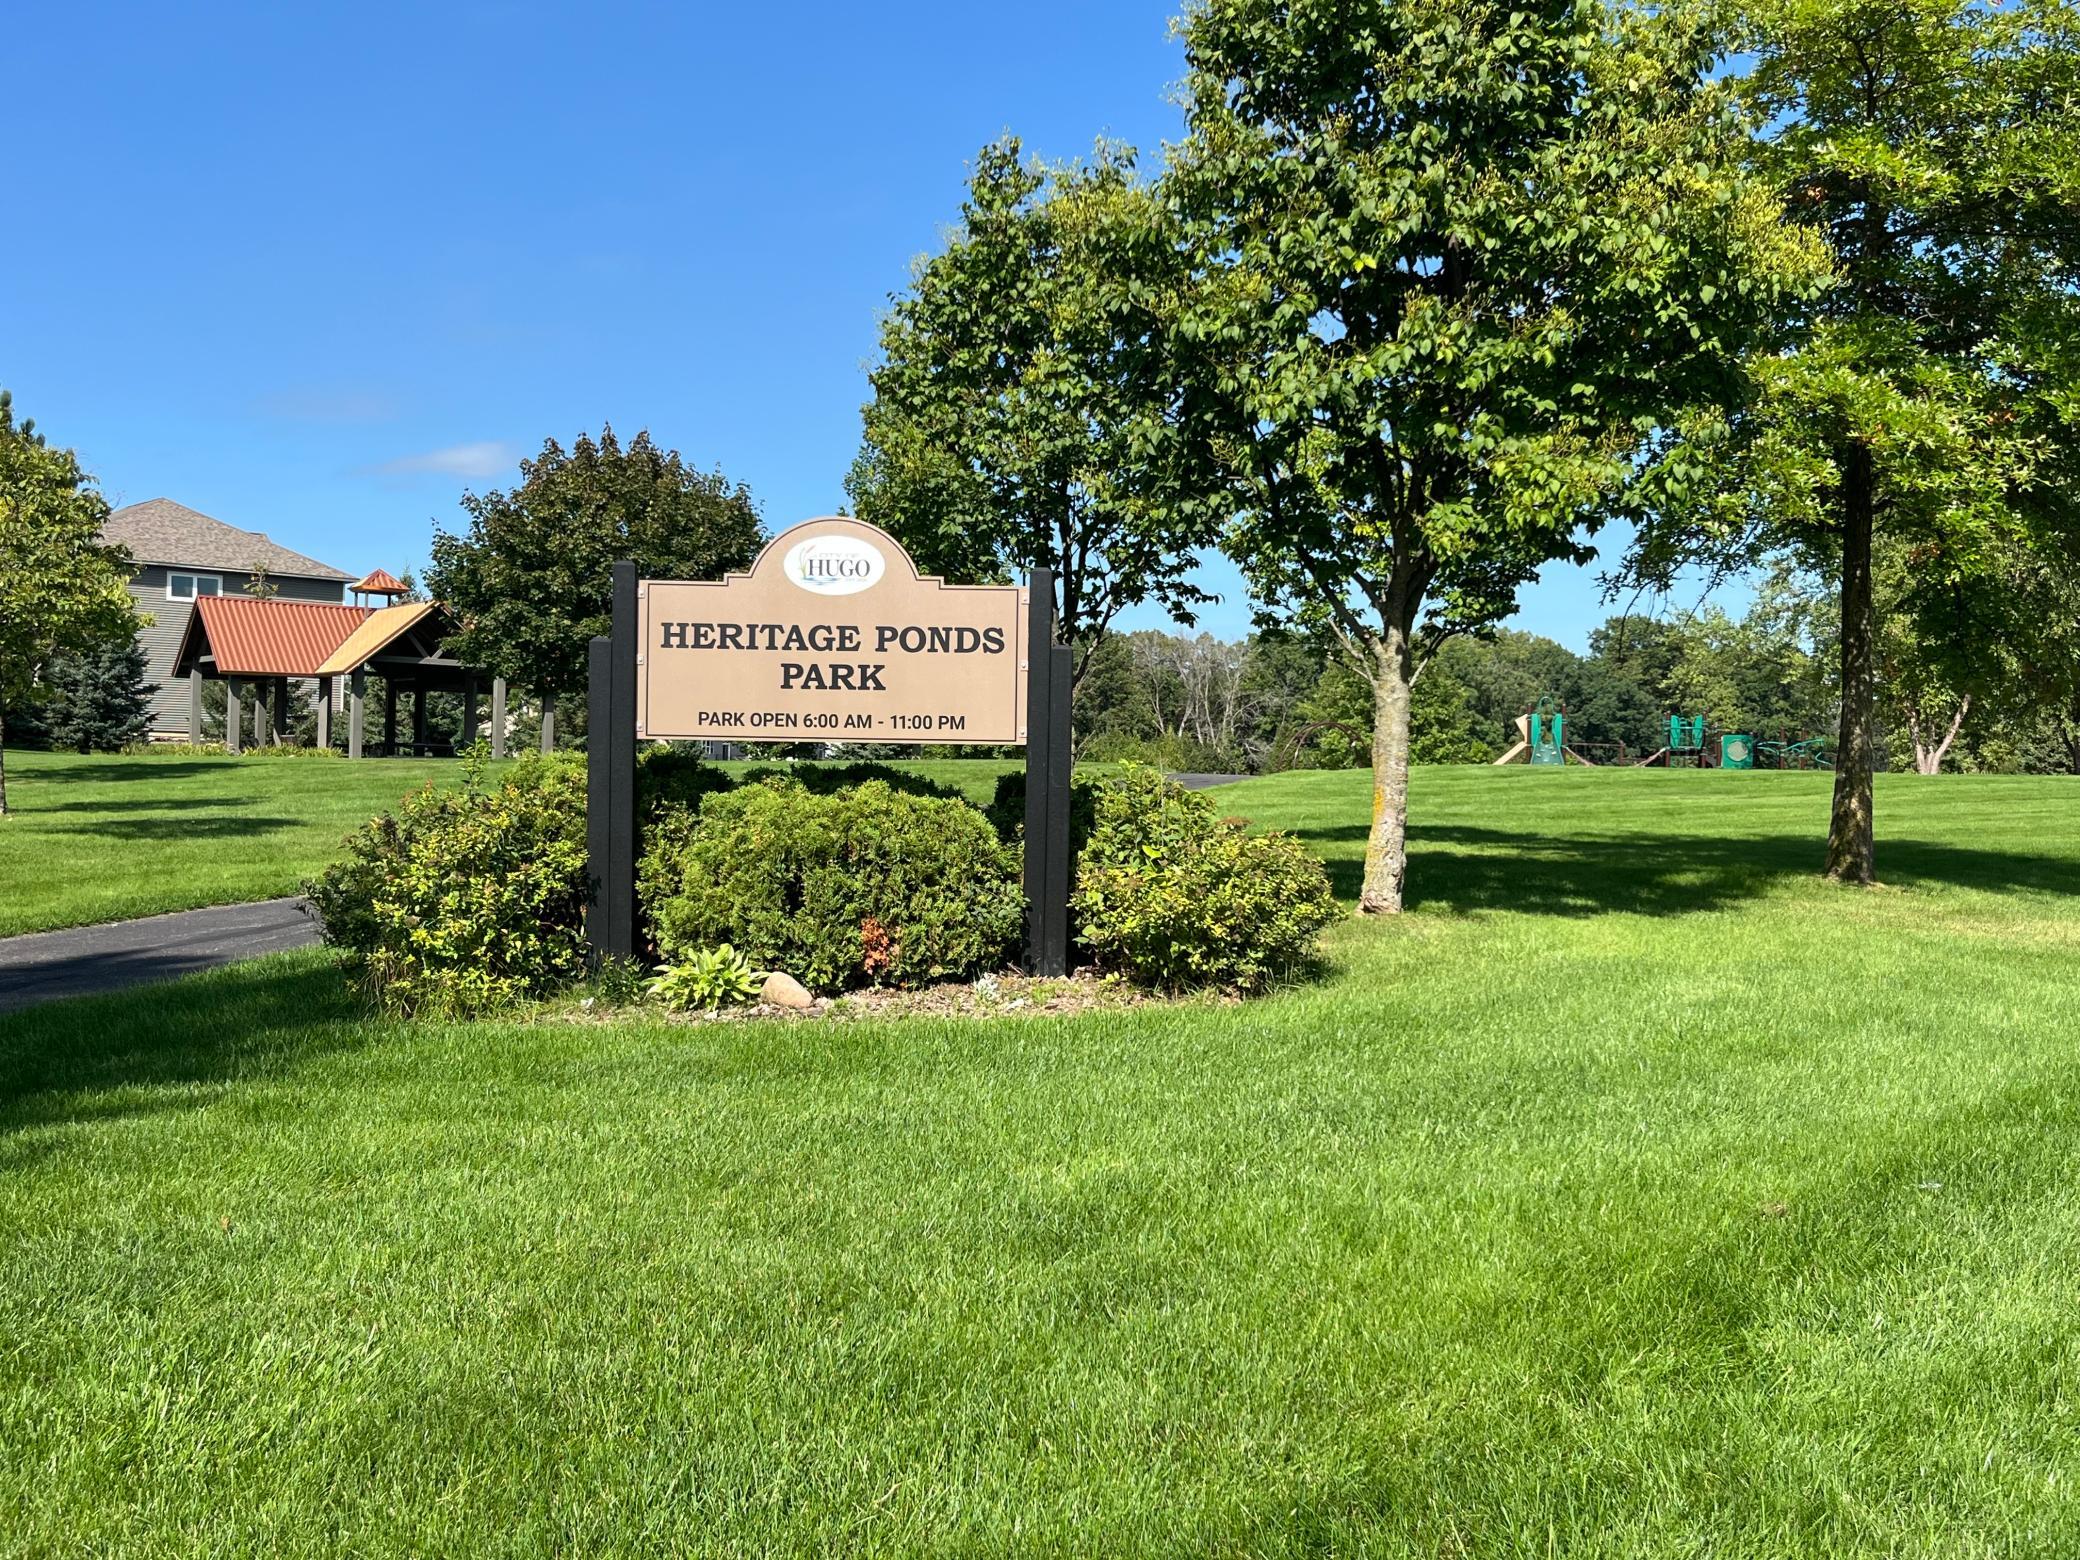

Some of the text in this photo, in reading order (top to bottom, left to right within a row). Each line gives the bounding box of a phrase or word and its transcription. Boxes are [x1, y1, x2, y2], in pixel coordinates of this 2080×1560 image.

[808, 558, 871, 577] HUGO
[660, 622, 1005, 655] HERITAGE PONDS
[780, 662, 887, 691] PARK
[698, 711, 745, 727] PARK
[751, 712, 798, 728] OPEN
[803, 713, 839, 729] 6:00
[843, 714, 872, 729] AM
[890, 714, 933, 730] 11:00
[938, 715, 965, 731] PM
